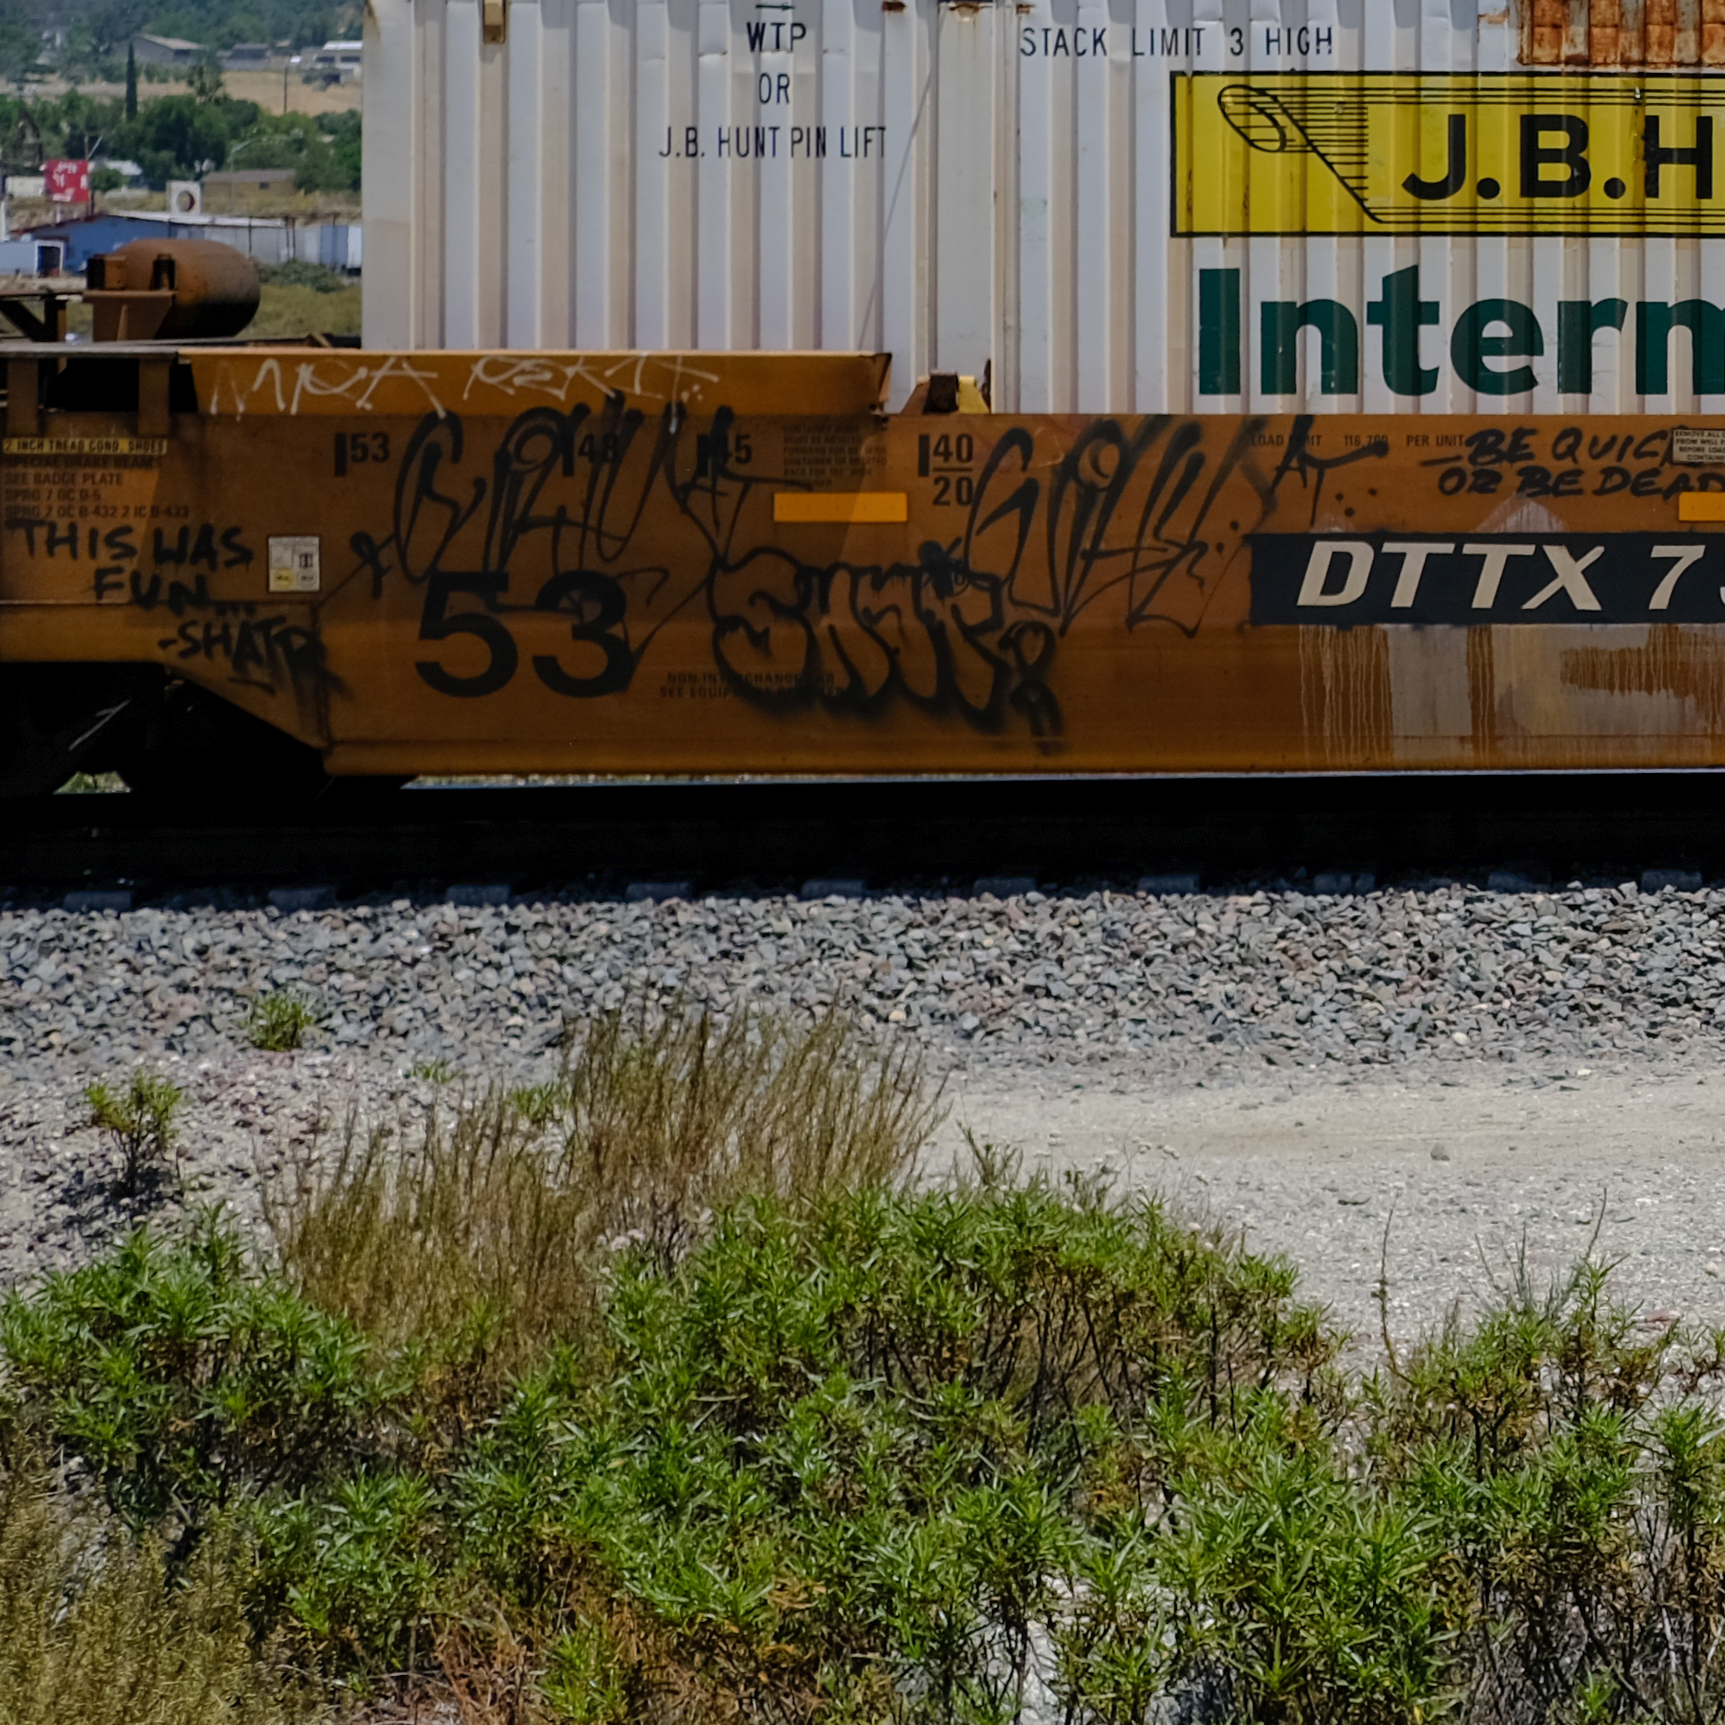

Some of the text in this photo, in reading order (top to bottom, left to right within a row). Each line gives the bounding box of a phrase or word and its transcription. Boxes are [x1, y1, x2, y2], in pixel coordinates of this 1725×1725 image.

[746, 21, 807, 54] WTP
[1019, 27, 1334, 58] STACK LIMIT 3 HIGH
[757, 72, 791, 105] OR
[658, 126, 887, 159] J.B. HUNT PIN LIFT
[349, 433, 390, 463] 53
[932, 433, 973, 464] 40
[1406, 435, 1429, 447] PER
[1436, 435, 1465, 447] UNIT
[1465, 428, 1538, 466] BE
[932, 476, 973, 507] 20
[1514, 467, 1585, 497] BE
[6, 519, 254, 571] THIS WAS
[1295, 540, 1606, 611] DTTX
[414, 570, 629, 699] 53
